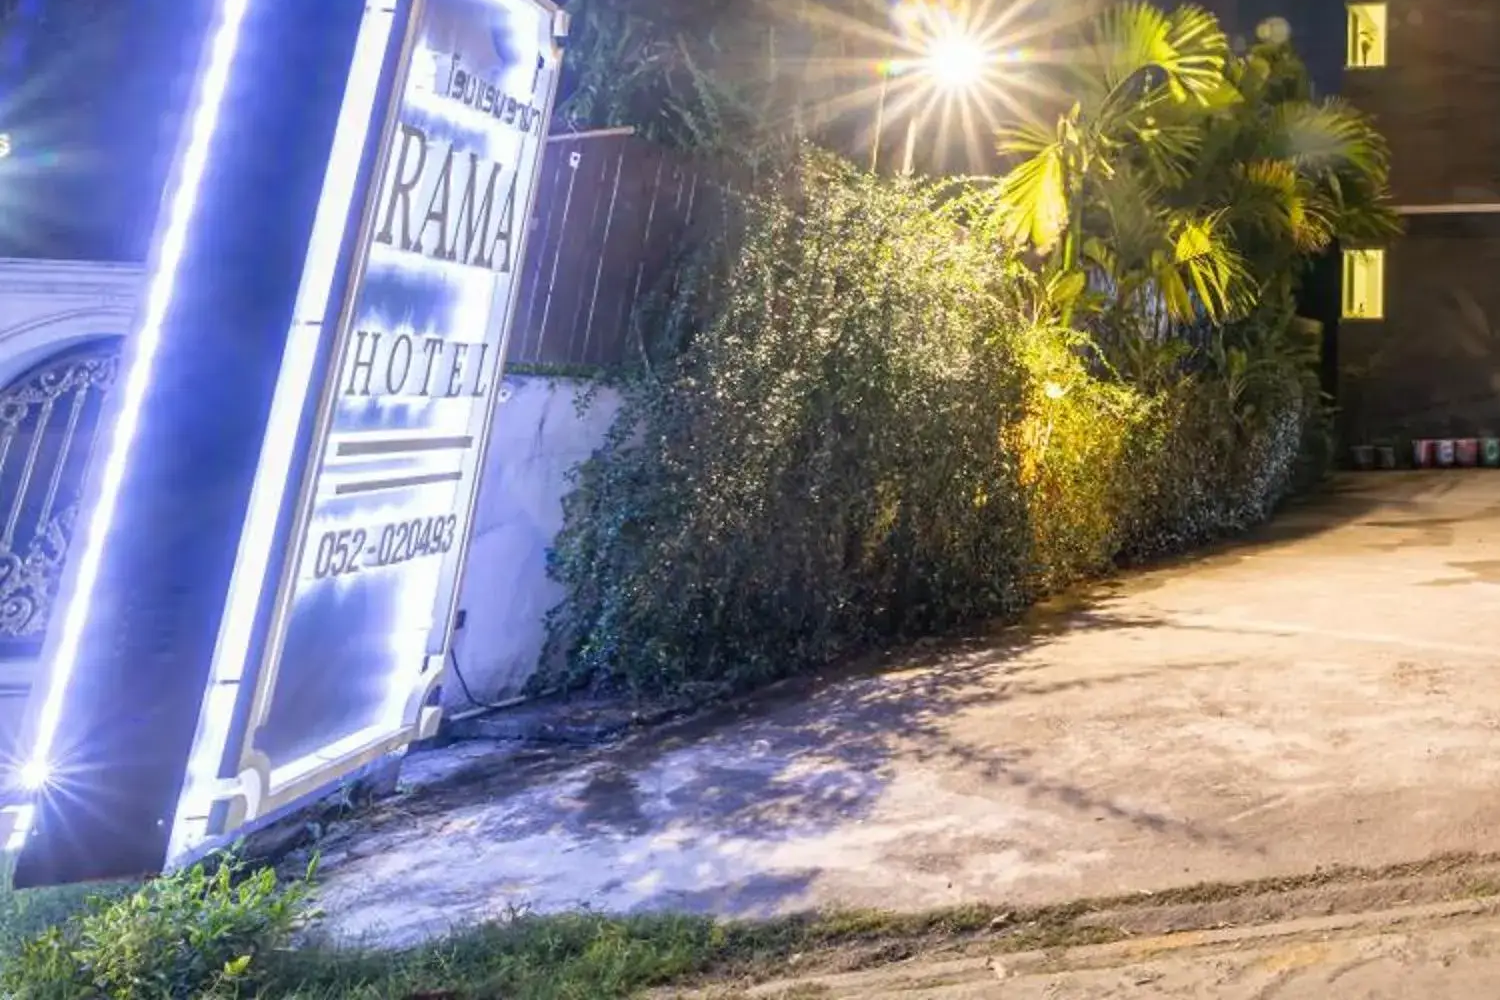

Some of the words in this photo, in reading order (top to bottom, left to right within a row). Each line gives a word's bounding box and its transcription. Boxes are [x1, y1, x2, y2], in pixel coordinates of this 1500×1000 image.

[375, 124, 518, 273] RAMA
[344, 329, 489, 397] HOTEL
[314, 513, 457, 579] 052-020493
